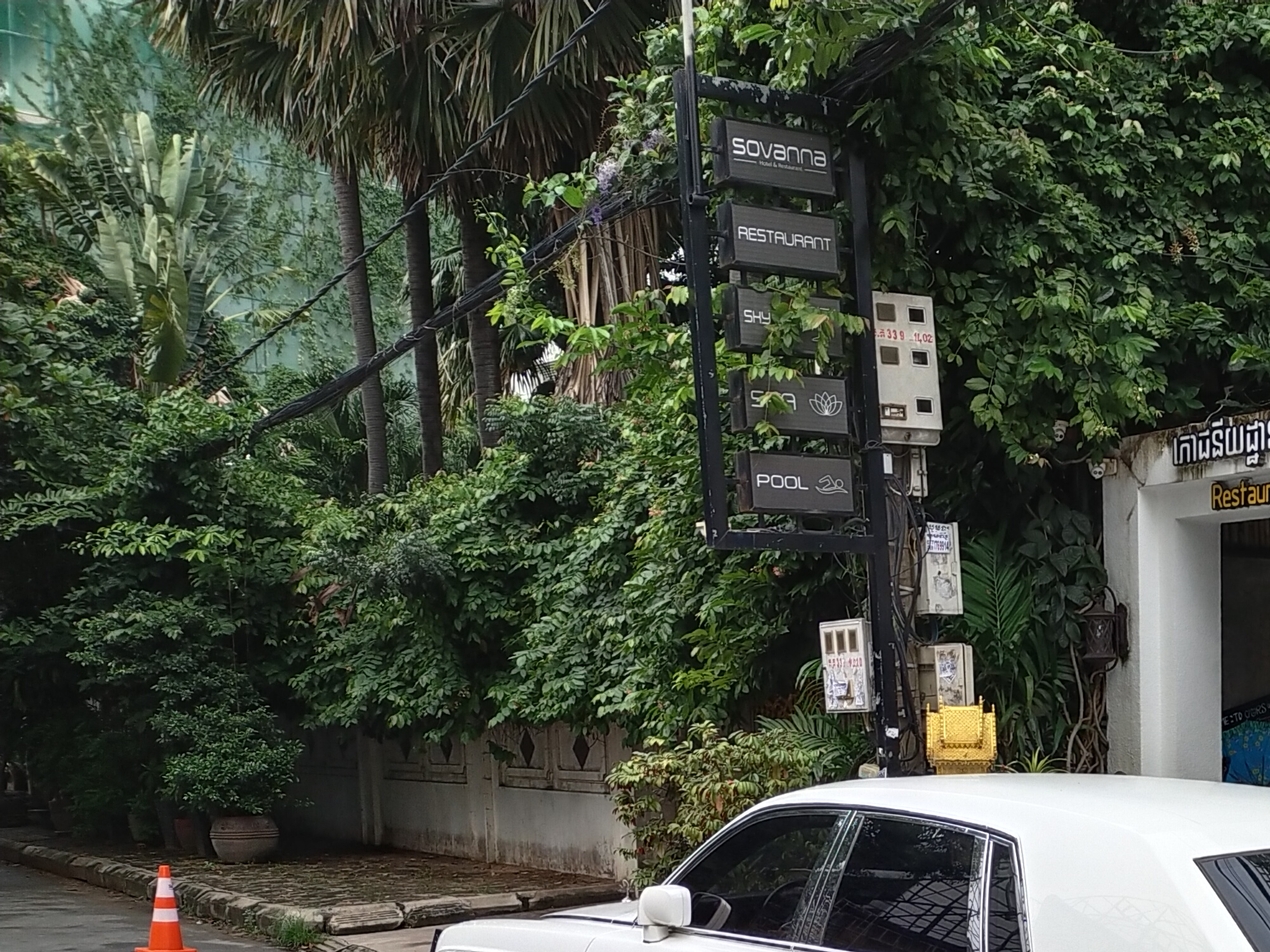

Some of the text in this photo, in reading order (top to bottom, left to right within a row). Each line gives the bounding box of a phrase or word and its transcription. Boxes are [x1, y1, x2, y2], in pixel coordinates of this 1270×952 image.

[738, 226, 831, 251] RESTAURANT
[743, 309, 771, 325] SKY
[751, 390, 797, 412] SA
[757, 474, 809, 490] POOL
